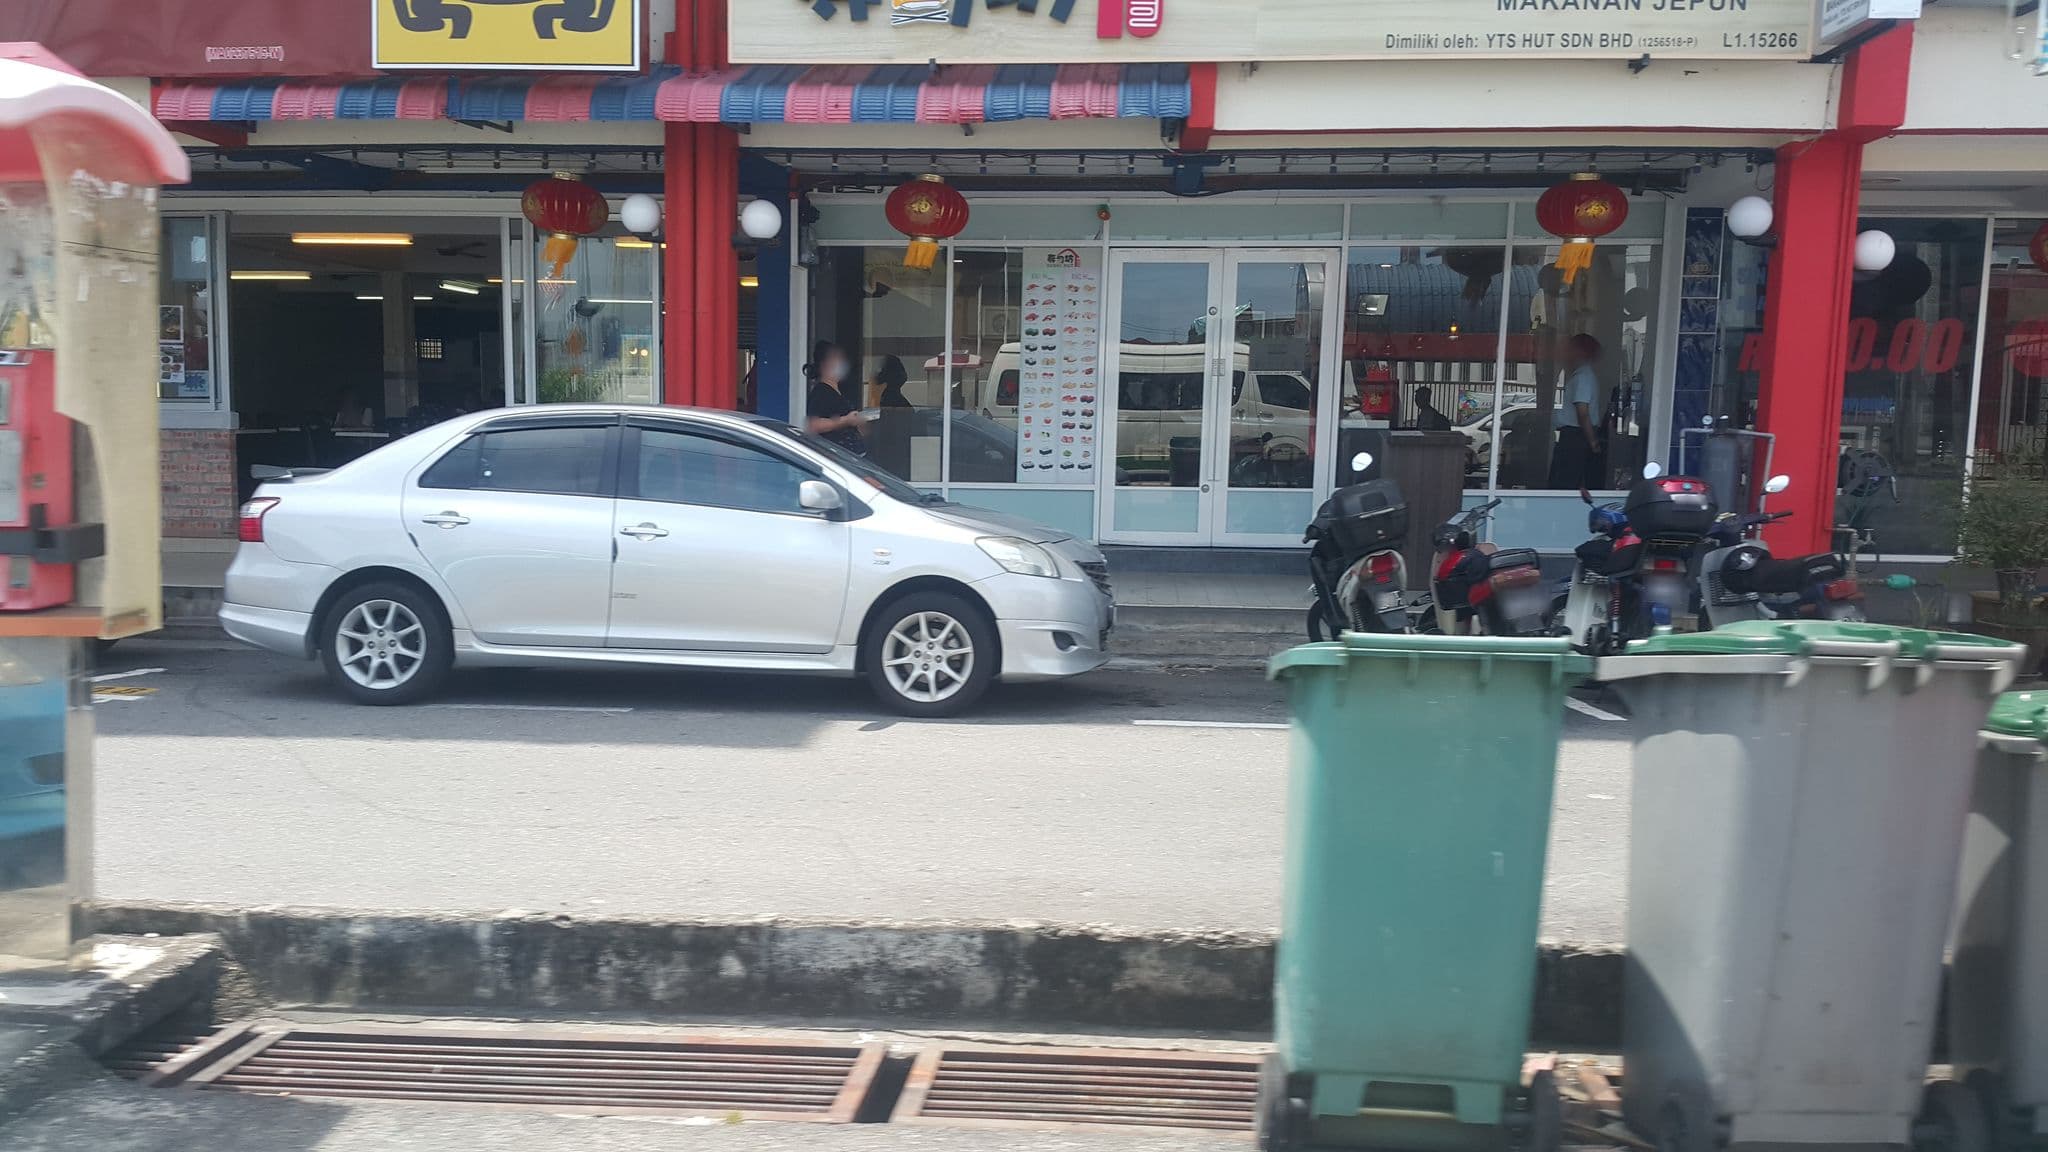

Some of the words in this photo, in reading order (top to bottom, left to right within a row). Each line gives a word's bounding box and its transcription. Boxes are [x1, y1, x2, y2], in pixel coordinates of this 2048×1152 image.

[1498, 0, 1641, 11] MAKANAN
[1652, 0, 1747, 11] JEPUN
[1386, 33, 1438, 49] Dimiliki
[1443, 33, 1479, 49] oleh:
[1486, 33, 1516, 48] YTS
[1522, 33, 1555, 48] HUT
[1560, 33, 1593, 48] SDN
[1600, 33, 1633, 48] BHD
[1638, 36, 1698, 48] (1256518-P)
[1722, 32, 1798, 48] L1.15266
